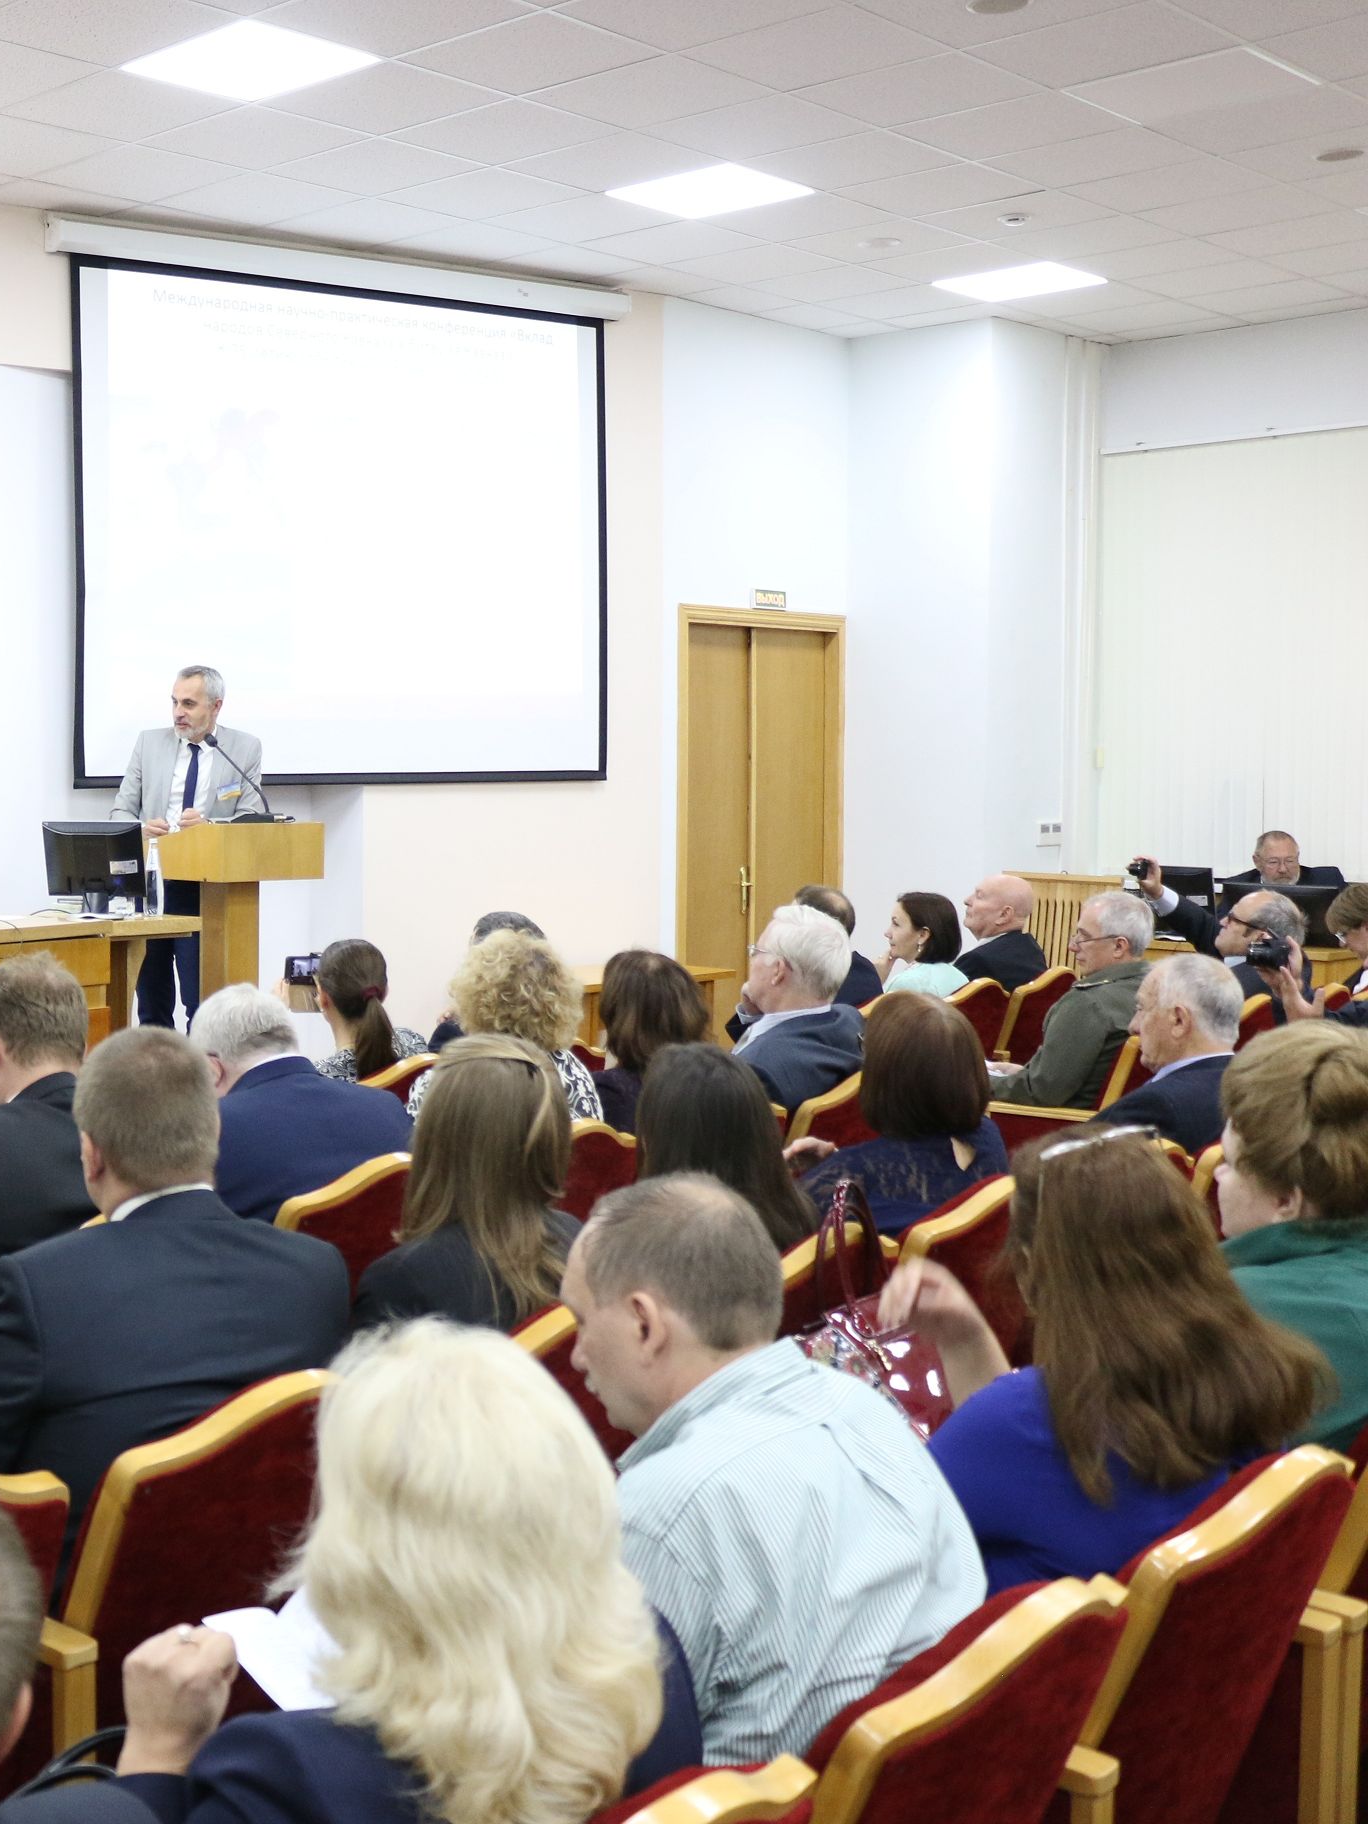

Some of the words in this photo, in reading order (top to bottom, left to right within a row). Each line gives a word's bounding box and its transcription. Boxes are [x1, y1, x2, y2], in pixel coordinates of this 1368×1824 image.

[152, 288, 273, 313] Международная
[277, 303, 419, 330] научно-практическая
[422, 318, 506, 338] конференция
[756, 592, 785, 607] ВЫХОД
